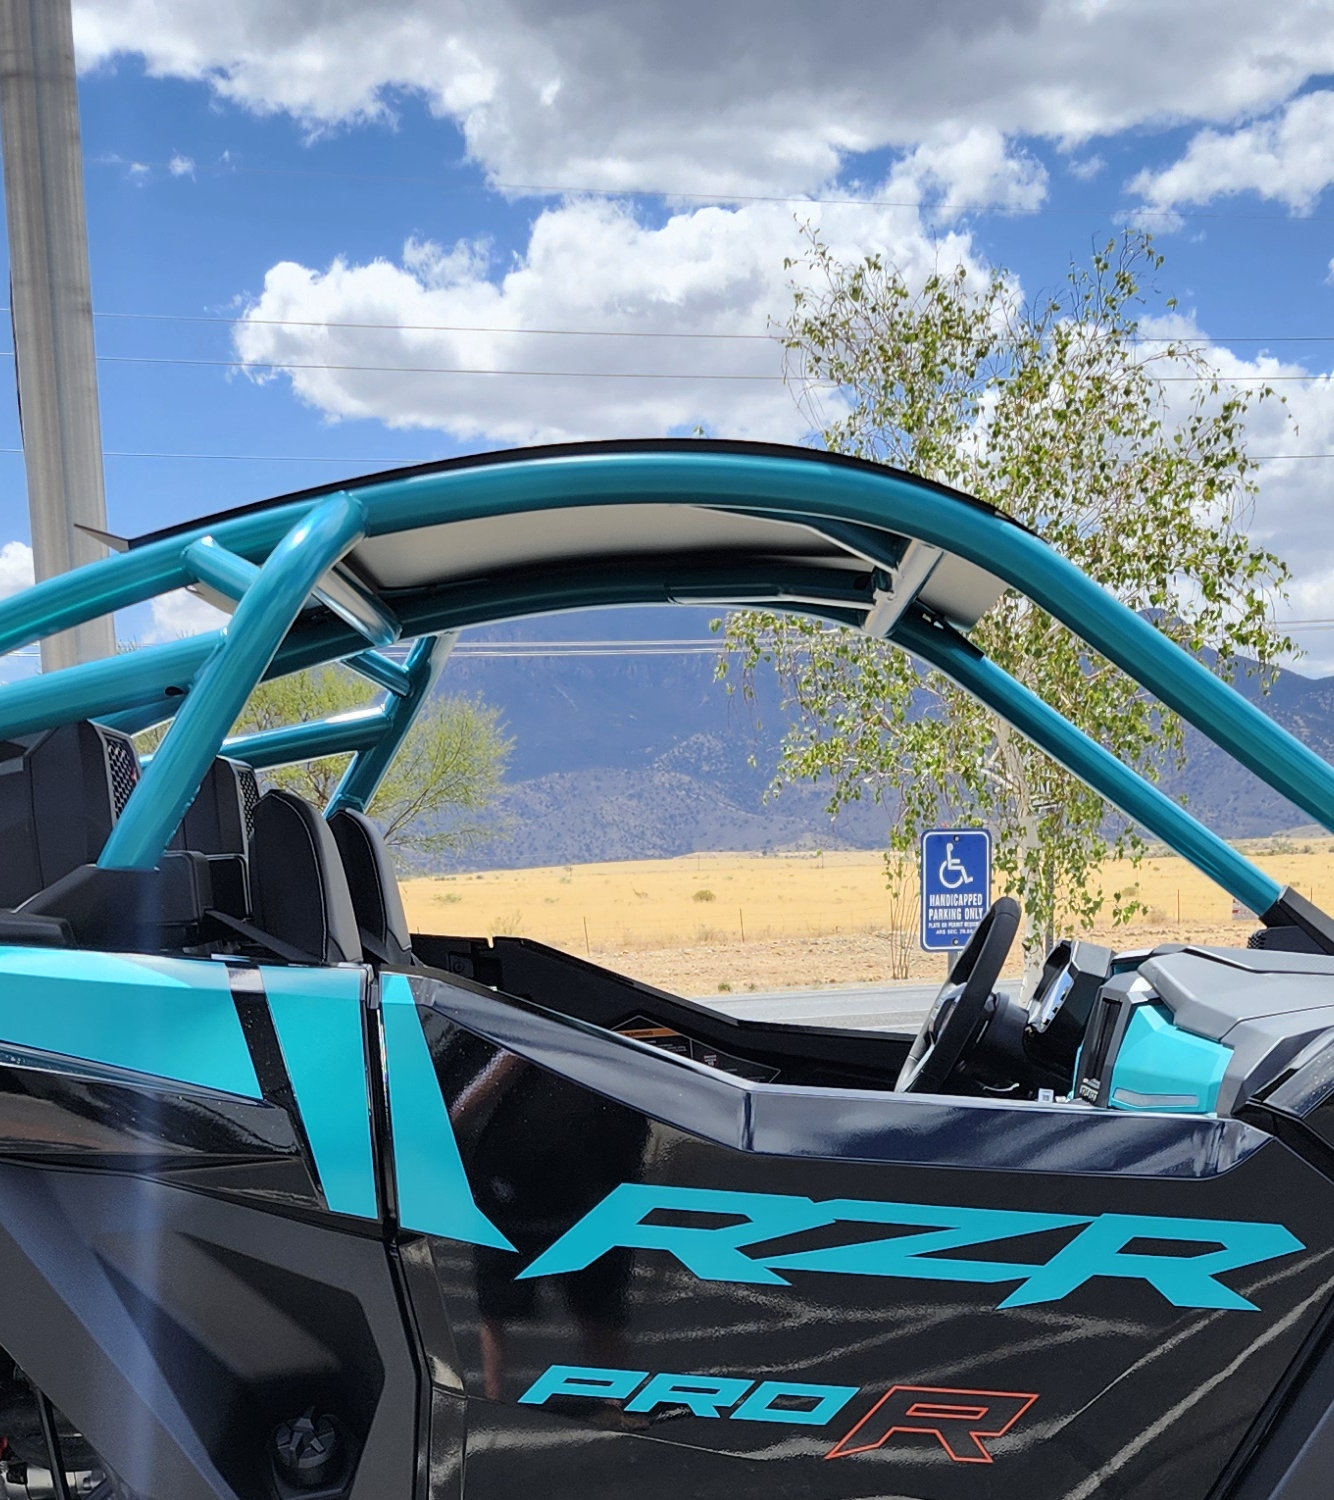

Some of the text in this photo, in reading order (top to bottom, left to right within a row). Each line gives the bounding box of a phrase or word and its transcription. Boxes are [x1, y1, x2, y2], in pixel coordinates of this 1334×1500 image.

[928, 907, 984, 921] PARKING ONLY
[929, 893, 982, 906] HANDICAPPED
[515, 1182, 1307, 1312] RZR
[517, 1364, 1041, 1464] PRO R
